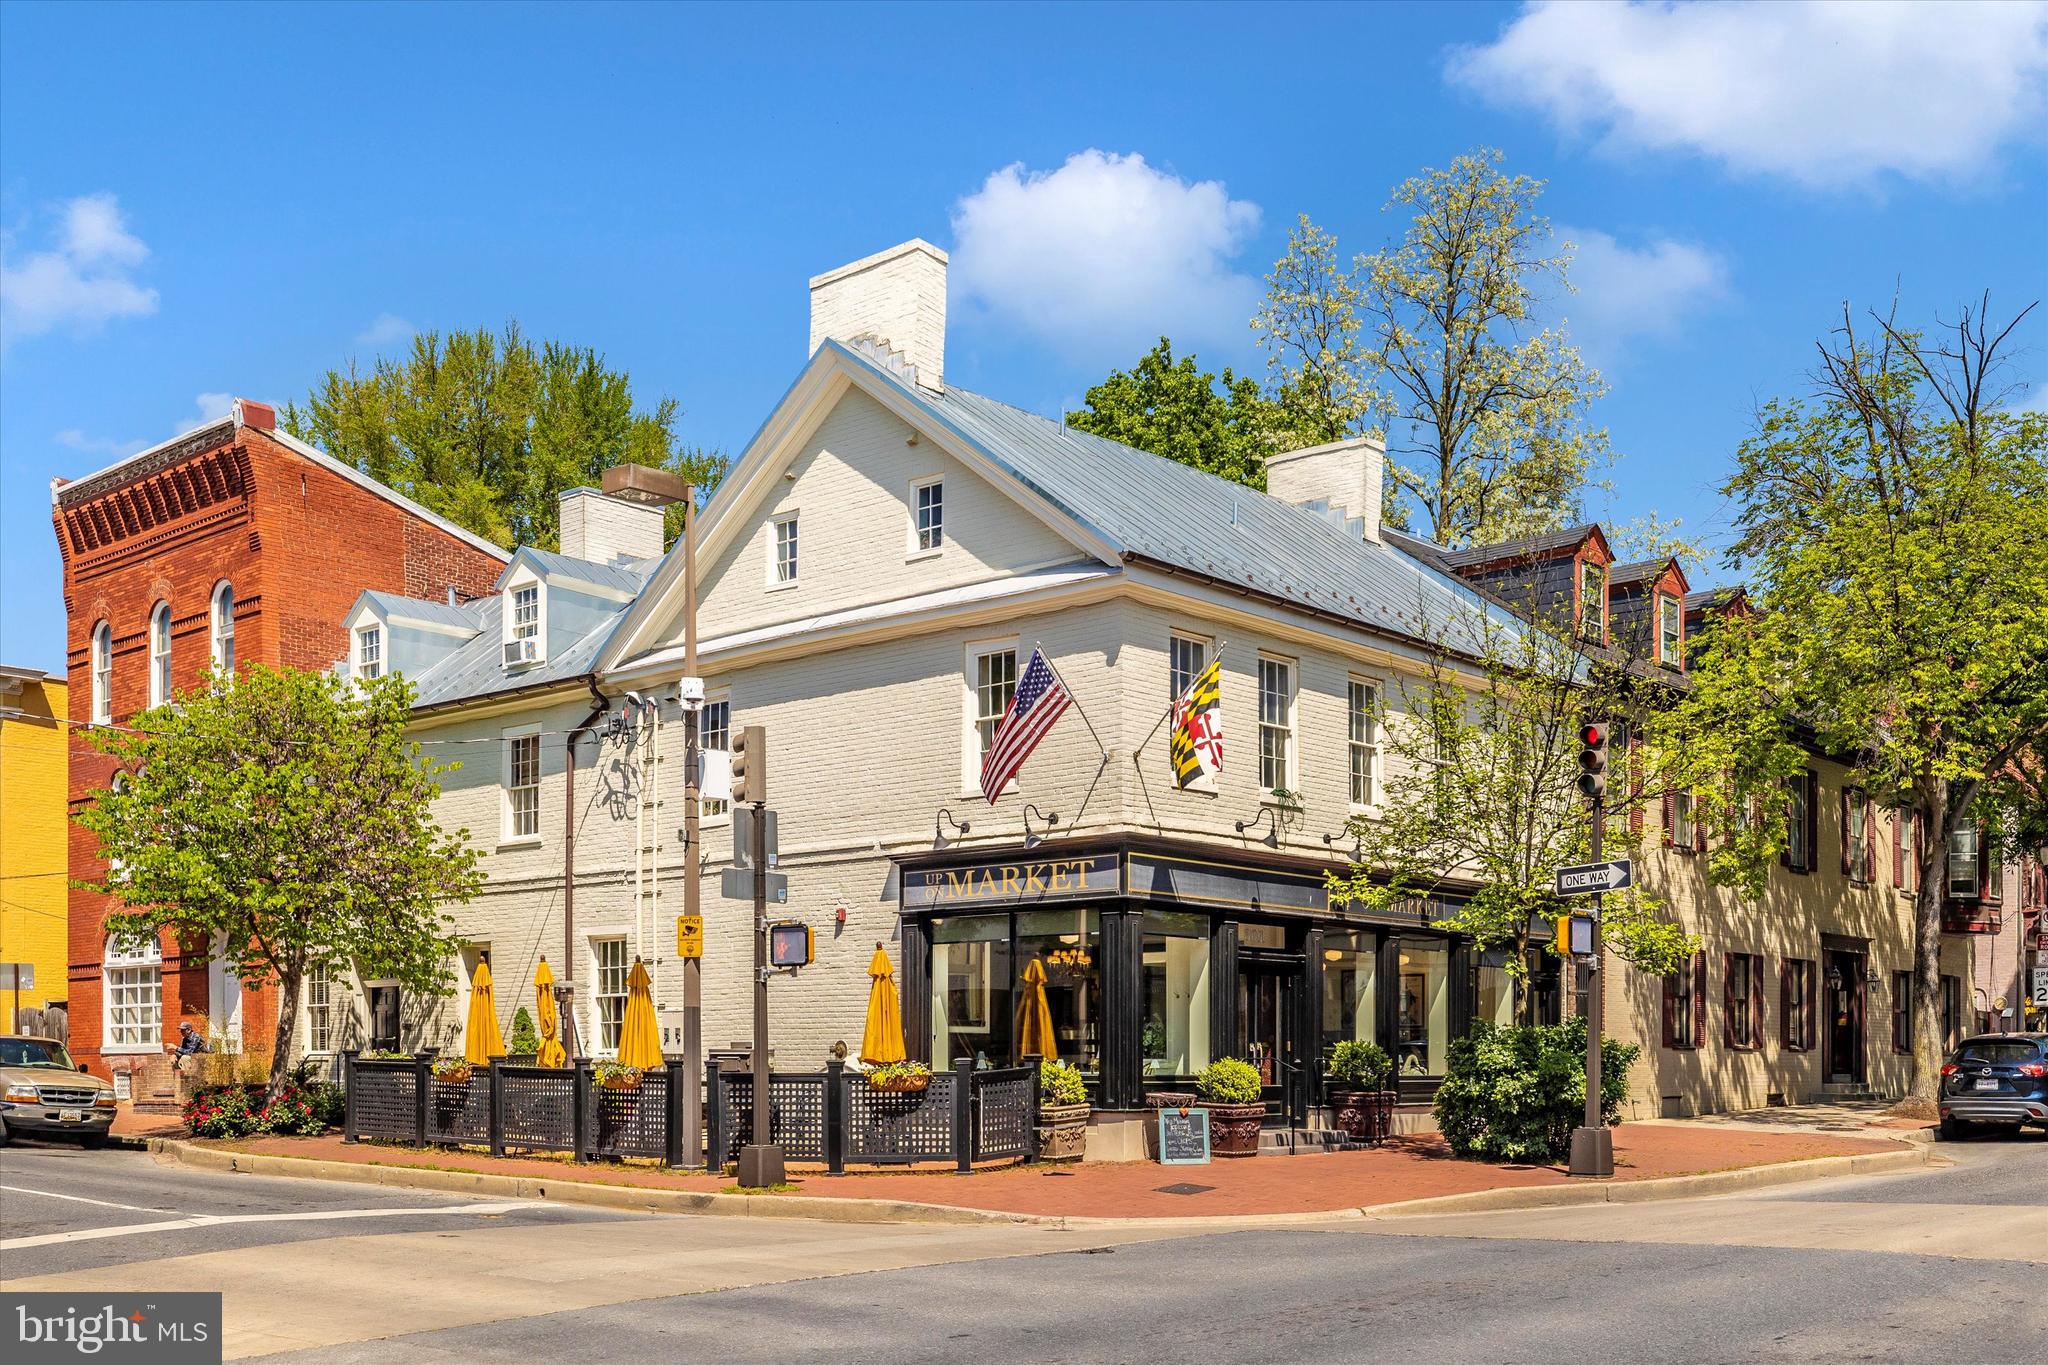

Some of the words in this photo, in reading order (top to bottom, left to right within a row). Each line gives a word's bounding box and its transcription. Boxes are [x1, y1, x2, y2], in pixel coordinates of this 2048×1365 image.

[925, 873, 943, 885] UP
[946, 859, 1095, 899] MARKET
[1566, 874, 1586, 886] ONE
[1589, 871, 1610, 883] WAY
[925, 887, 943, 899] ON
